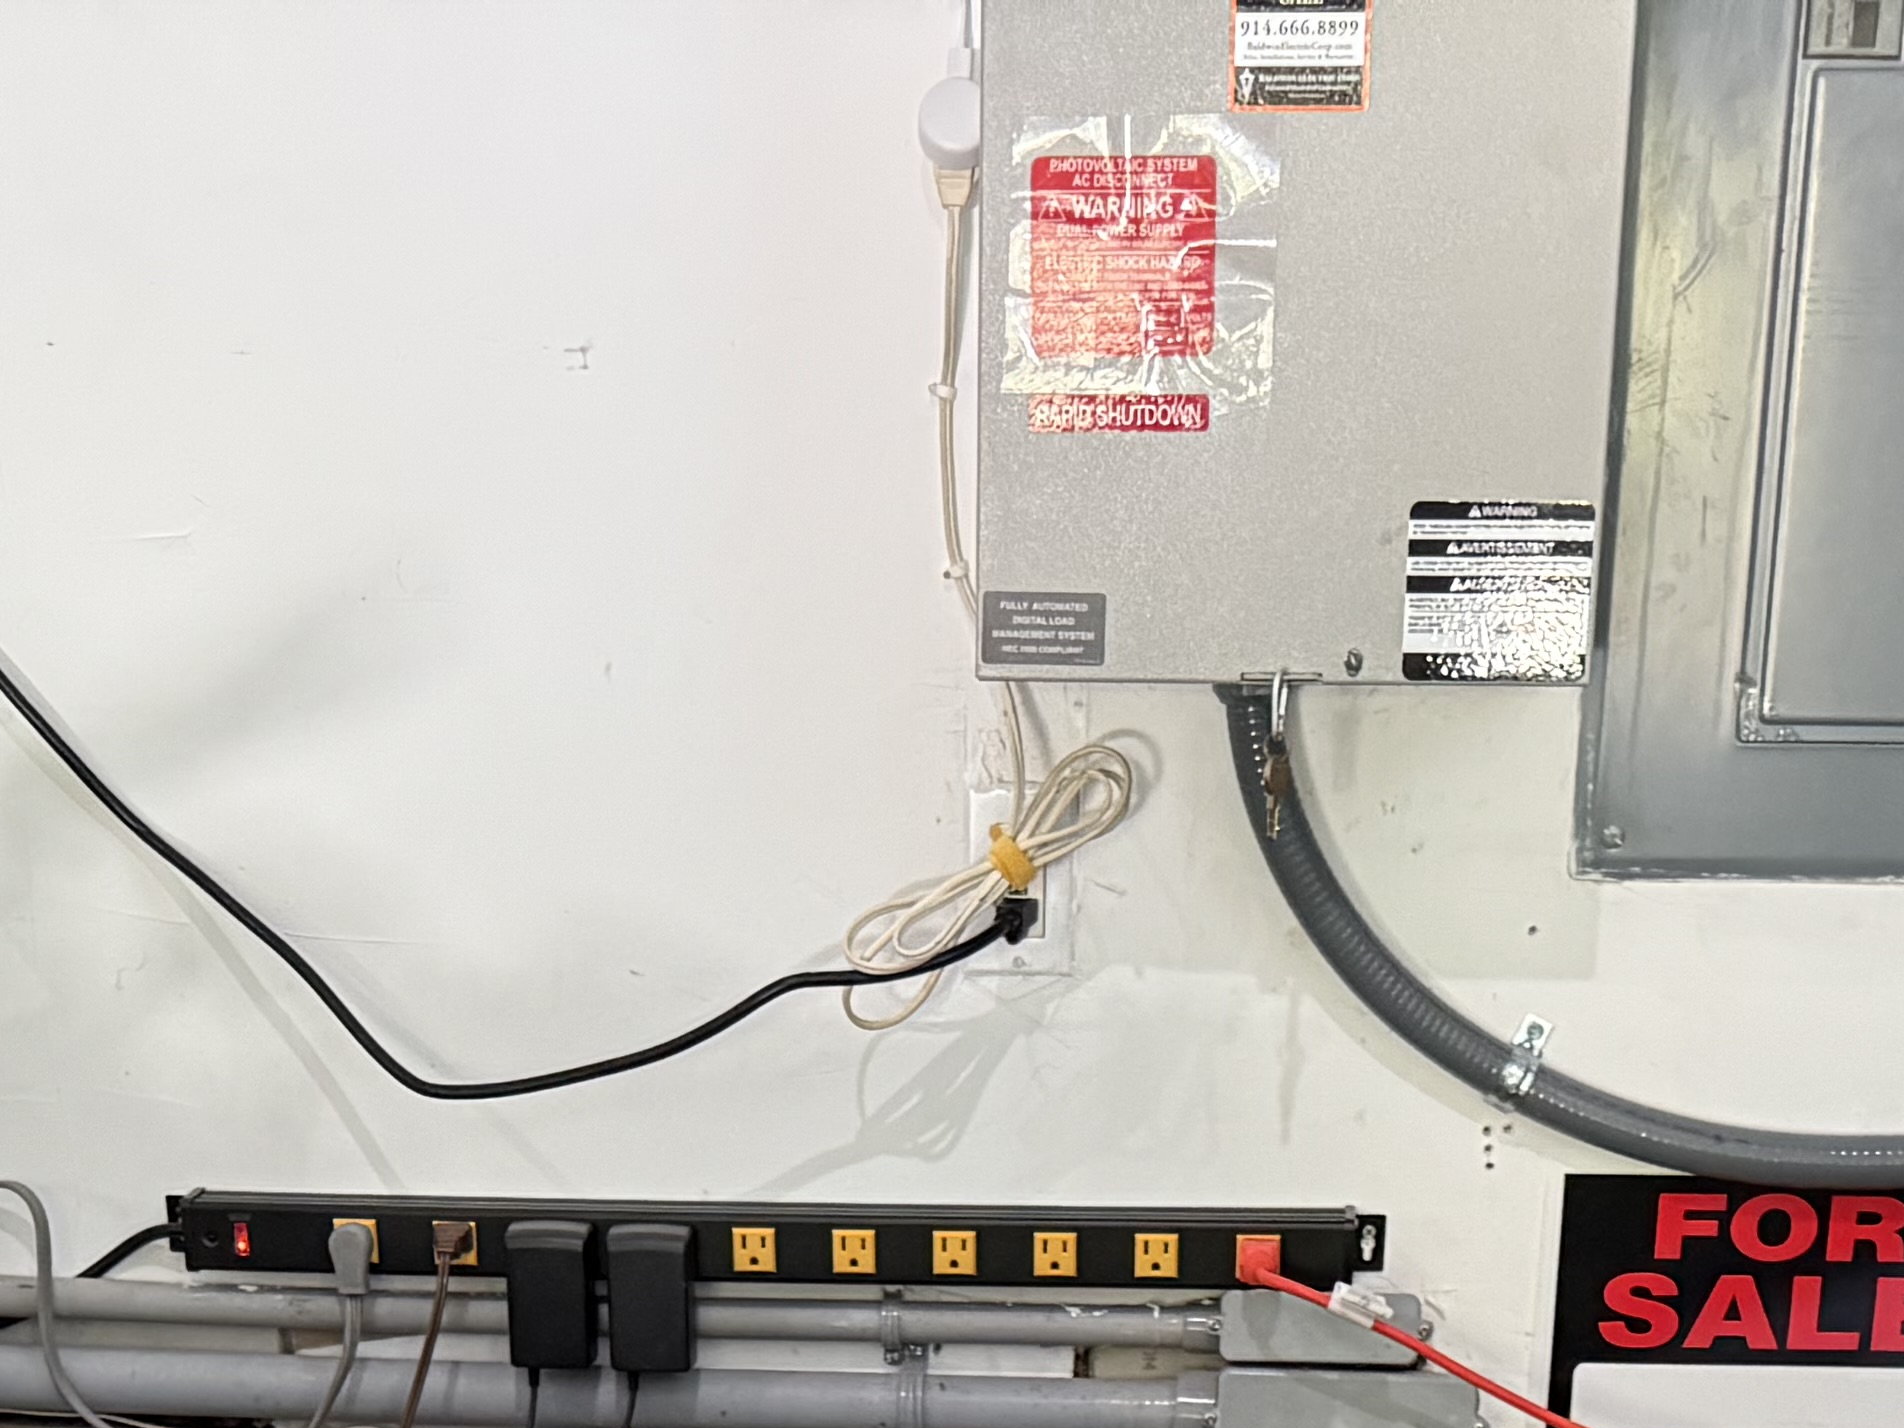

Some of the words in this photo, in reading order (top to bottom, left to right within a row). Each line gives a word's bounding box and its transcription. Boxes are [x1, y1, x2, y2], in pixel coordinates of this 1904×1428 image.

[1241, 19, 1359, 36] 914.666.8899
[1049, 157, 1144, 173] PHOTOVOLTAIC
[1147, 158, 1198, 173] SYSTEM
[1072, 173, 1089, 187] AC
[1093, 173, 1174, 188] DISCONNECT
[1072, 194, 1174, 219] WARNING
[1139, 222, 1184, 237] SUPPLY
[1106, 255, 1148, 269] SHOCK
[1096, 402, 1203, 427] SHUTDOWN
